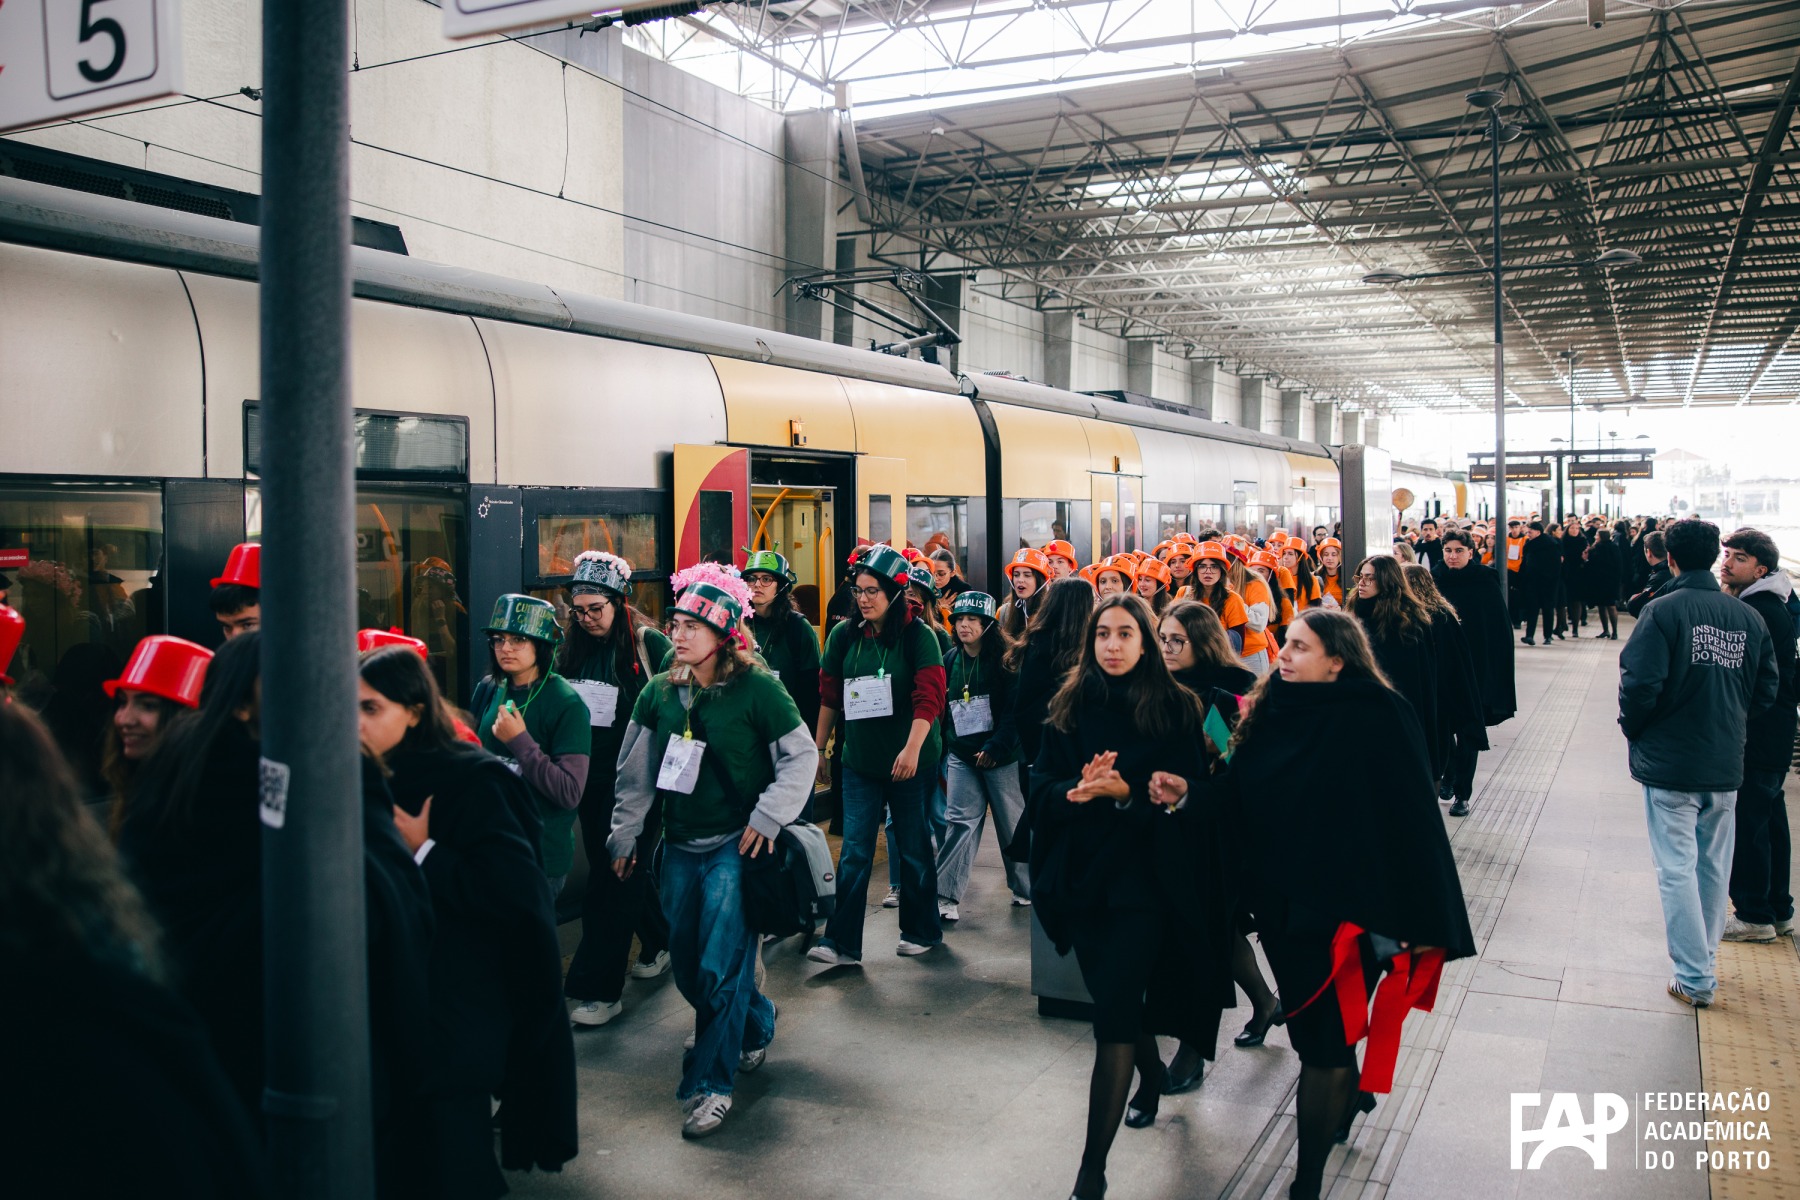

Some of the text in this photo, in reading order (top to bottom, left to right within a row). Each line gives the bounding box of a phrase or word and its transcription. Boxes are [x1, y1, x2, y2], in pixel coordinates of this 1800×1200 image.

[78, 0, 126, 83] 5
[1692, 625, 1746, 642] INSTITUTO
[1692, 634, 1745, 652] SUPERIOR
[1703, 643, 1744, 659] ENGENHARIA
[1691, 651, 1743, 669] DO PORTO
